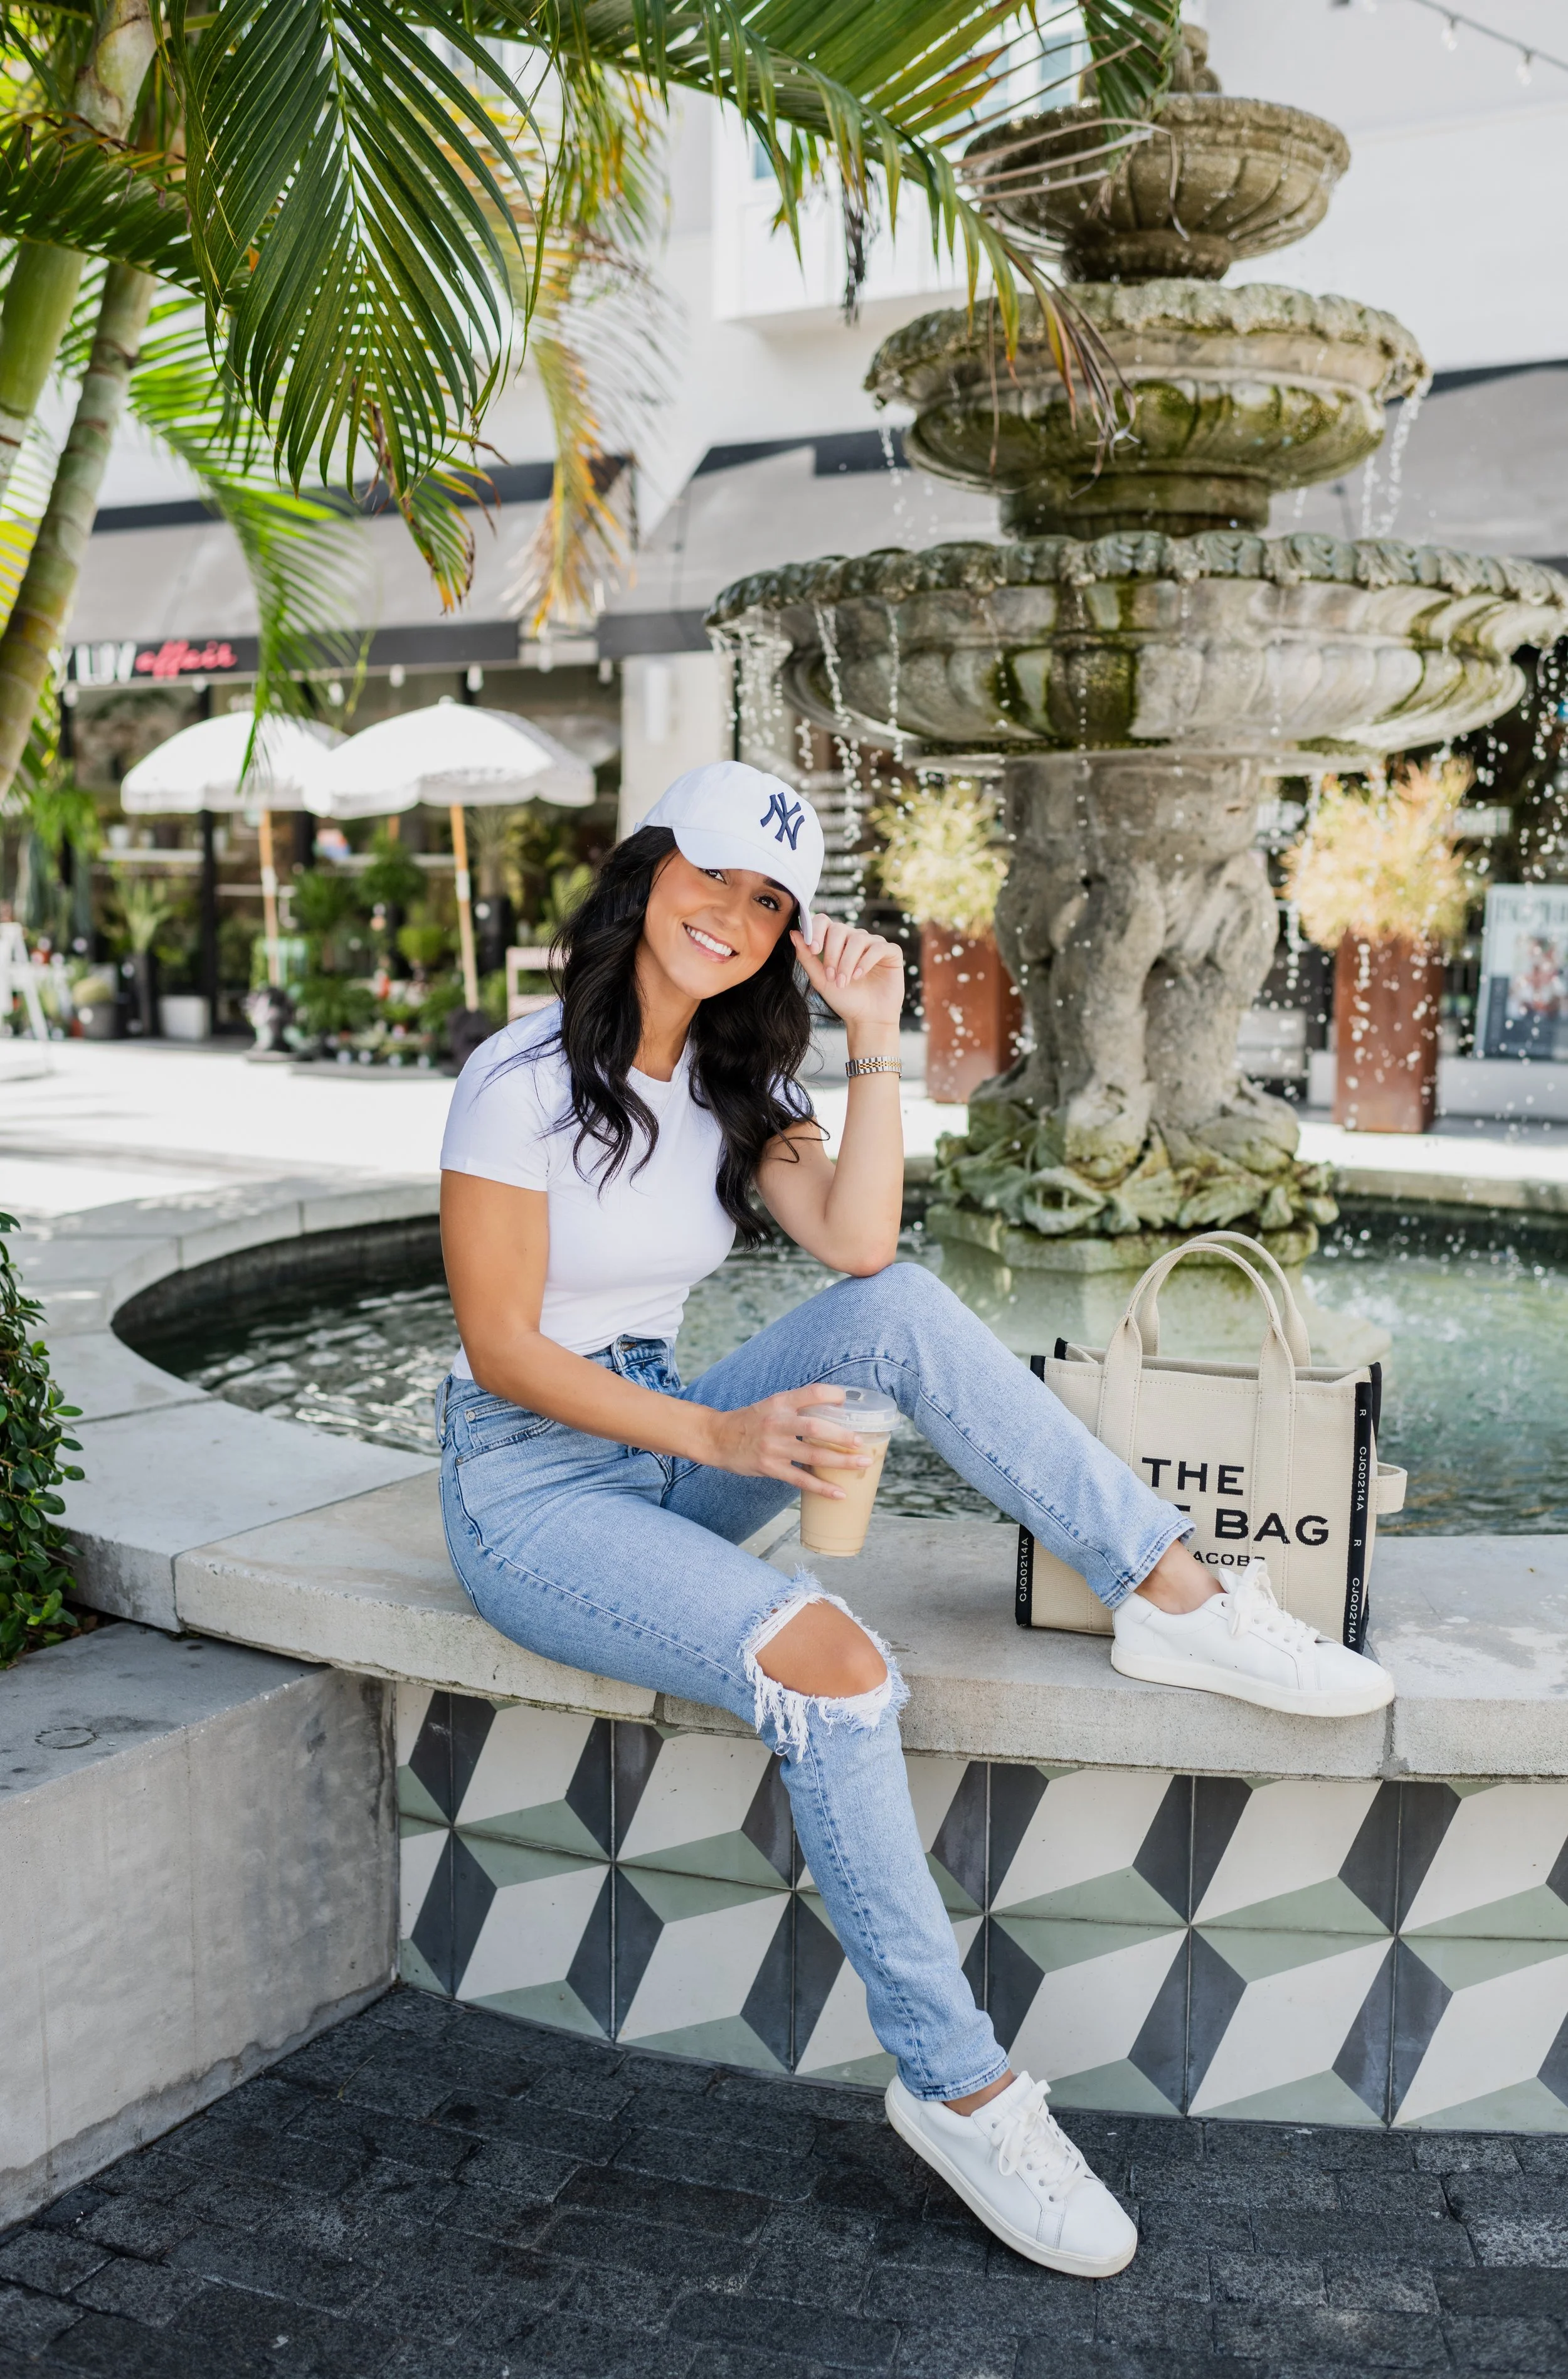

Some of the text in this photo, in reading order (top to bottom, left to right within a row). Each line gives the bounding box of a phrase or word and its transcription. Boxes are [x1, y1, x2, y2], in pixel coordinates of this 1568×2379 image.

[760, 792, 805, 850] NY
[1142, 1457, 1244, 1496] THE
[1356, 1446, 1367, 1511] CJQ0214A
[1215, 1508, 1328, 1546] BAG
[1019, 1537, 1029, 1602] CJQ0214A
[1187, 1549, 1266, 1567] ACOB
[1348, 1577, 1360, 1643] CJQ0214A
